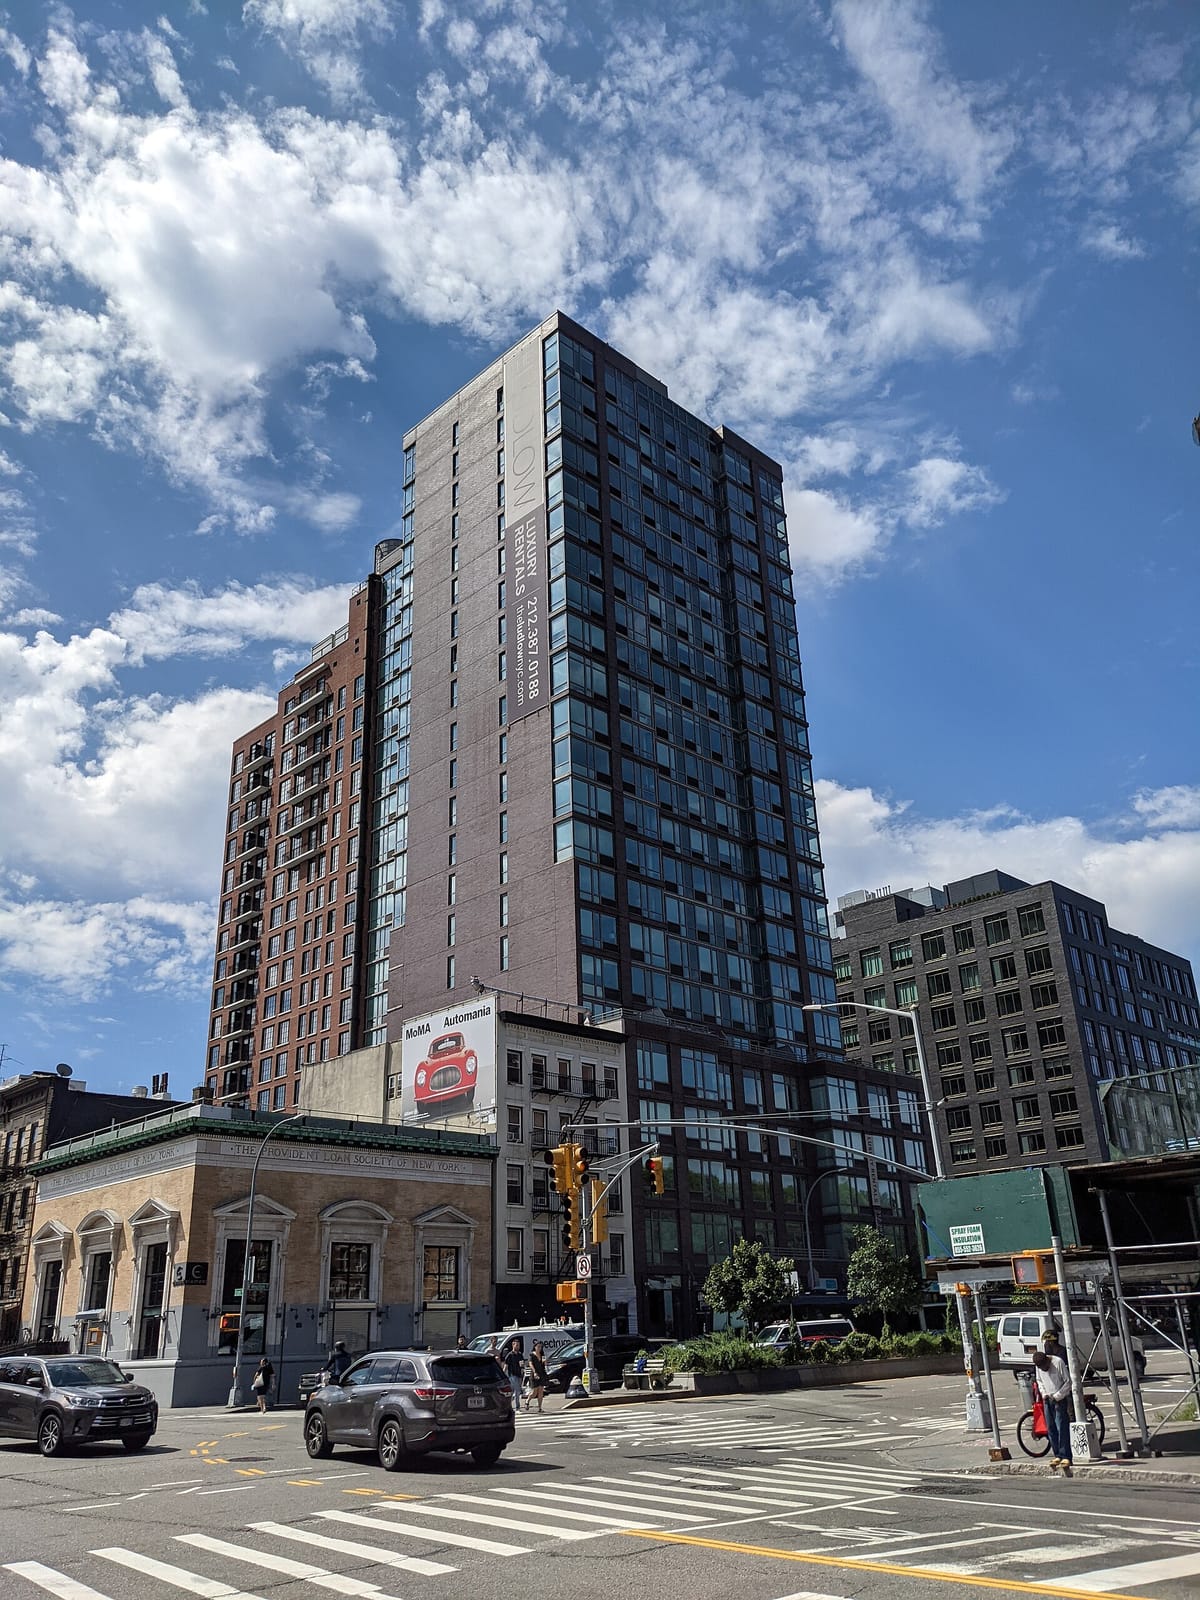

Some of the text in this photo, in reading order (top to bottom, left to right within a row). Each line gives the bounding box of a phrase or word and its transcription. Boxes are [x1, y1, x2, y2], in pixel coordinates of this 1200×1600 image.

[514, 524, 526, 597] RENTALS
[526, 516, 537, 577] LUXURY
[515, 604, 526, 707] theludlownyc.com
[527, 597, 540, 700] 212.387.0188
[405, 1022, 431, 1040] MoMA
[443, 1006, 491, 1028] Automania
[236, 1144, 257, 1155] THE
[261, 1147, 320, 1161] PROVIDENT
[353, 1154, 393, 1167] SOCIETY
[397, 1157, 408, 1168] OF
[412, 1159, 433, 1170] NEW
[438, 1161, 461, 1172] YORK
